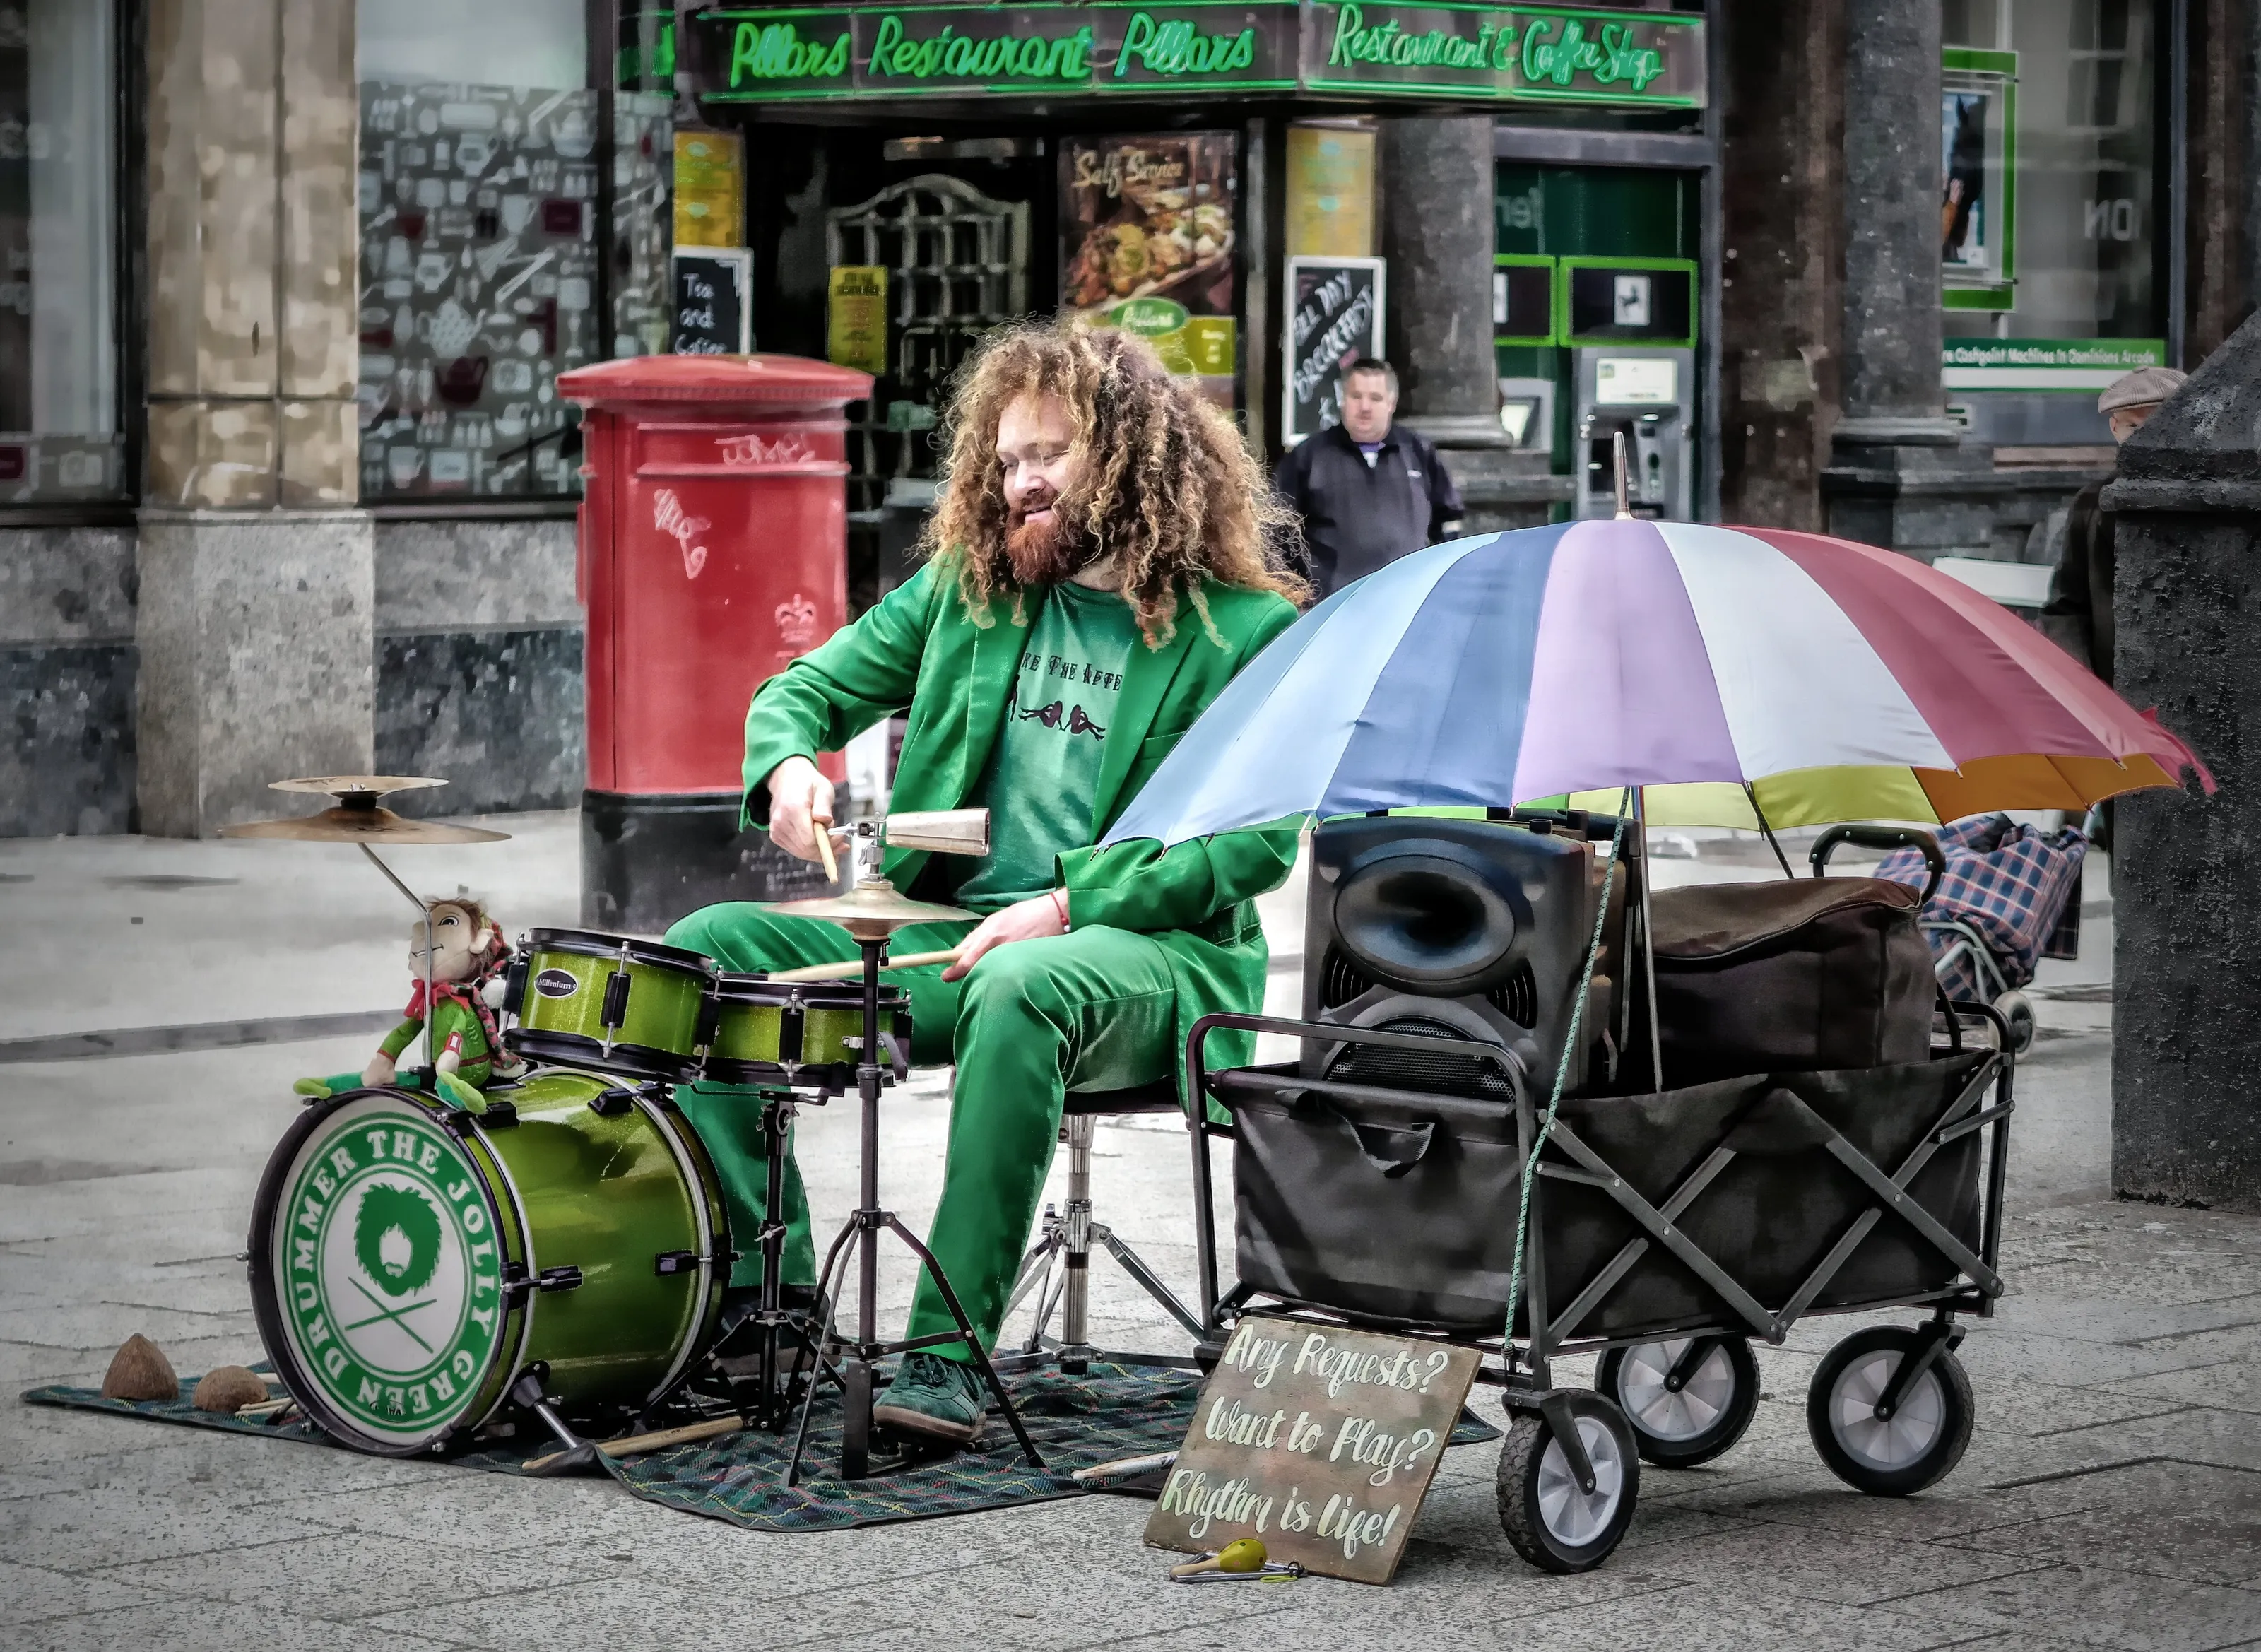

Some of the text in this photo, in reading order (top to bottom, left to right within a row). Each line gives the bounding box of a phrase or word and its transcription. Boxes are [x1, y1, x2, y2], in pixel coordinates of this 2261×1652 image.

[730, 11, 1256, 88] Pillars Restaurant Pillars
[1328, 3, 1497, 69] Restaurant
[1521, 18, 1603, 86] Coffee
[1592, 22, 1665, 92] Shop
[1072, 146, 1185, 199] Self Service
[678, 302, 716, 330] and
[682, 272, 716, 300] Tea
[1314, 269, 1352, 317] DAY
[1955, 346, 2005, 367] Cashpoint
[2007, 347, 2055, 364] Machines
[2120, 348, 2156, 365] Arcade
[538, 978, 571, 989] Millenium
[366, 1129, 442, 1175] THE
[294, 1145, 356, 1381] DRUMMER
[447, 1178, 495, 1338] JOLLY
[355, 1349, 474, 1417] GREEN
[1224, 1323, 1449, 1400] Any Requests?
[1205, 1396, 1435, 1488] Want to Play?
[1160, 1468, 1273, 1540] Rhythm
[1280, 1486, 1313, 1534] is
